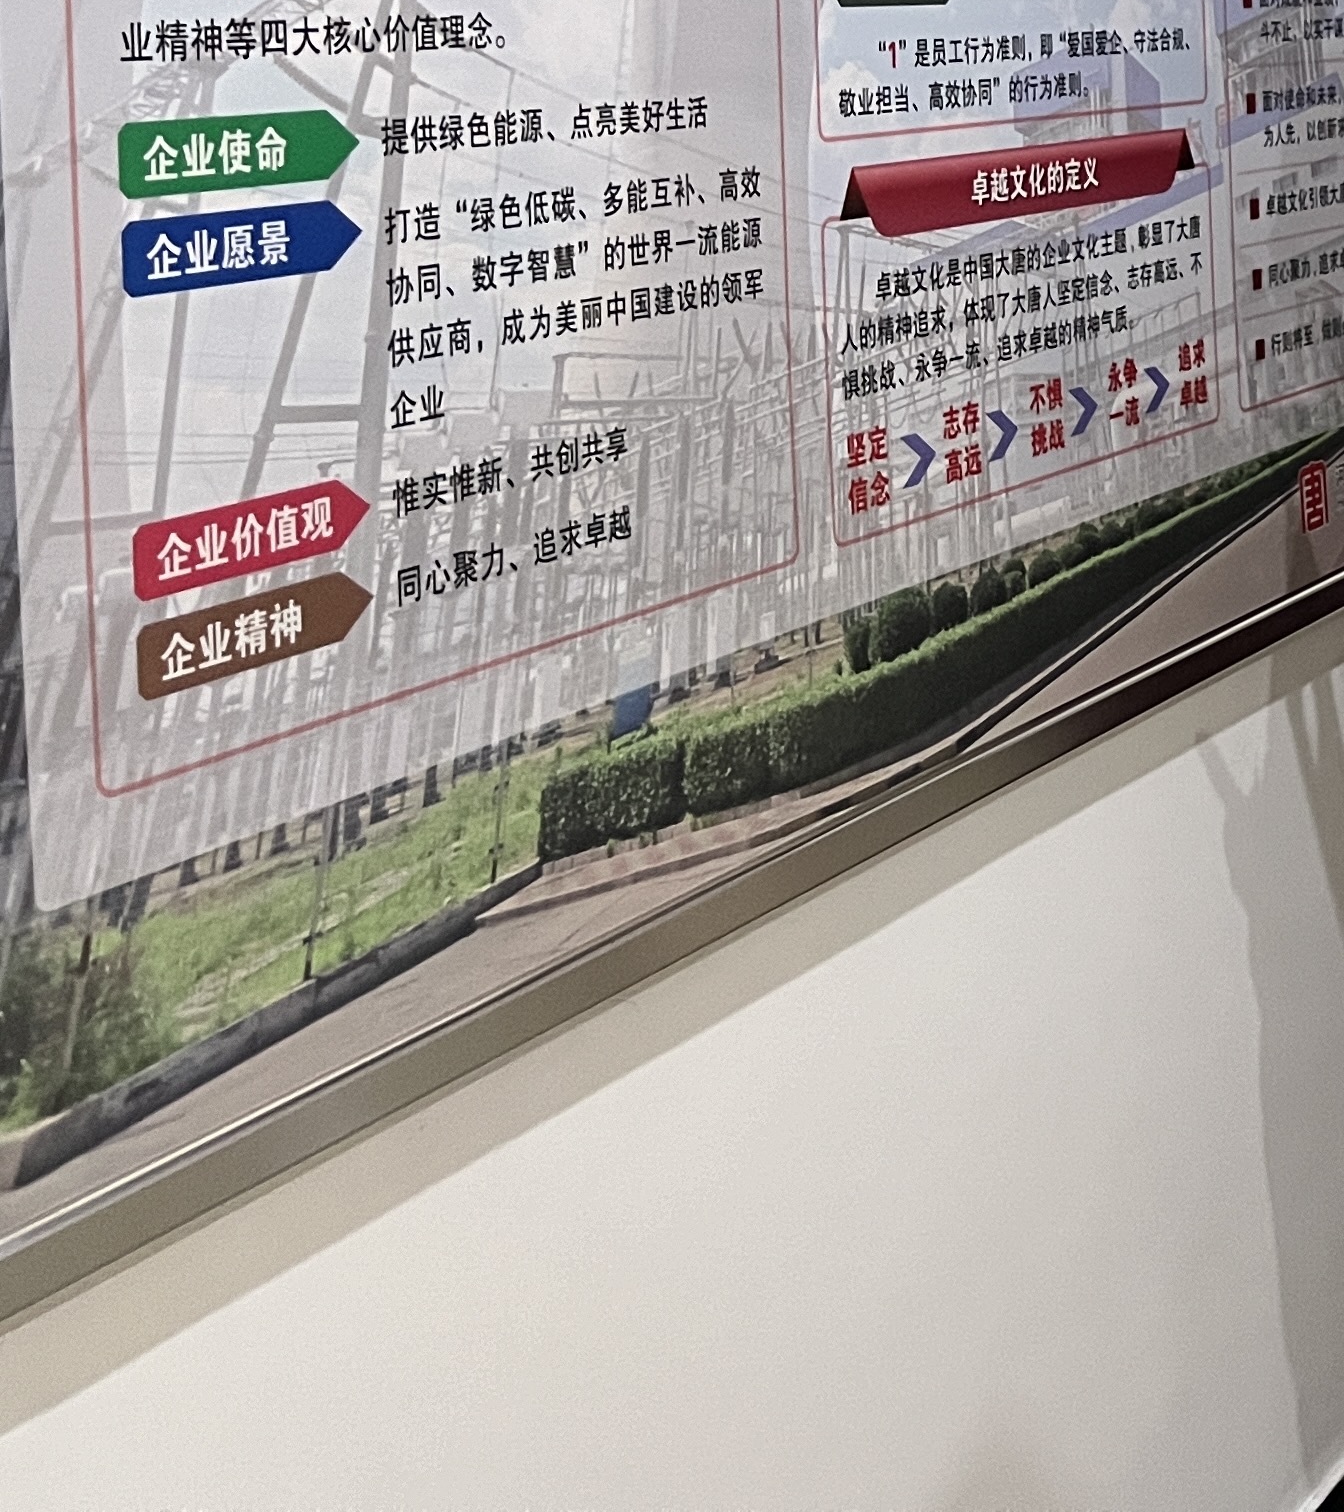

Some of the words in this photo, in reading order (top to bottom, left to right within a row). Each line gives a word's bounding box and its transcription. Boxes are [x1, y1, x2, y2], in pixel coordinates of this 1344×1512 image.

[120, 11, 507, 64] 业精神等四大核心价值理念。
[380, 95, 709, 157] 提供绿色能源、点亮美好生活
[143, 127, 288, 182] 企业使命
[971, 157, 1099, 206] 卓越文化的定义
[385, 165, 761, 246] 打造“绿色低碳、多能互补、高效
[146, 220, 291, 281] 企业愿景
[386, 216, 762, 307] 协同、数字智慧”的世界一流能源
[387, 268, 764, 367] 供应商，成为美丽中国建设的领军
[1108, 358, 1138, 393] 永争
[1178, 338, 1206, 373] 追求
[390, 385, 445, 429] 企业
[1029, 378, 1064, 415] 不惧
[1109, 398, 1140, 427] 一流
[1180, 381, 1208, 407] 卓越
[943, 401, 980, 441] 志存
[1030, 419, 1066, 457] 挑战
[846, 426, 889, 469] 坚定
[945, 445, 982, 484] 高远
[848, 471, 891, 516] 信念
[156, 496, 334, 581] 企业价值观
[397, 505, 632, 607] 同心聚力、追求卓越
[161, 600, 303, 681] 企业精神
